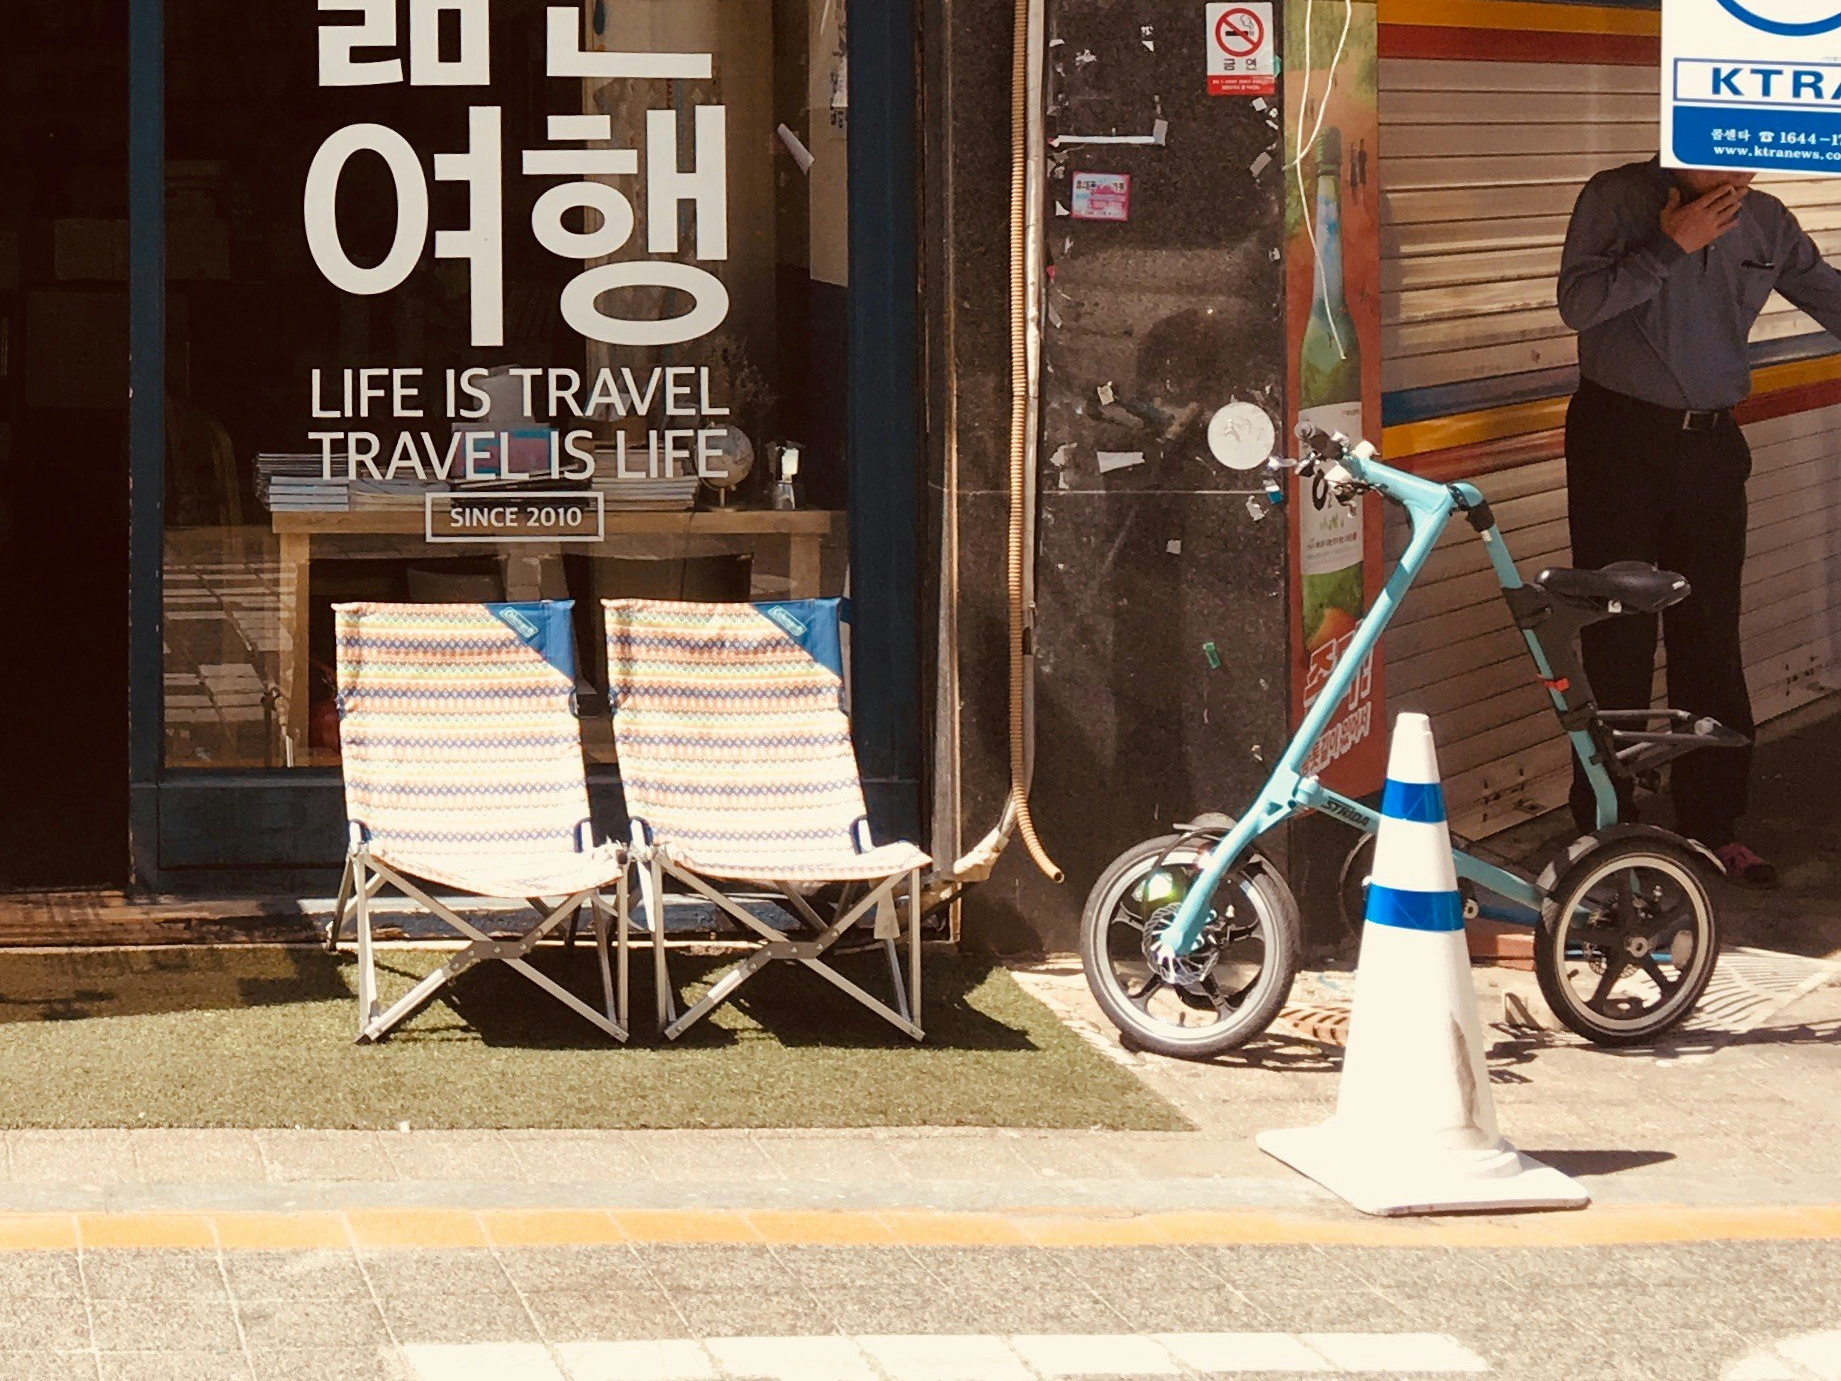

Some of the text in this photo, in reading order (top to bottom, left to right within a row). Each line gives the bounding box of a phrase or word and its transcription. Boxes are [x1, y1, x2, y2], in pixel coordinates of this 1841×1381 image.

[304, 105, 729, 347] 여행
[311, 366, 730, 418] LIFE IS TRAVEL
[308, 428, 729, 481] TRAVEL IS LIFE
[450, 506, 582, 528] SINCE 2010
